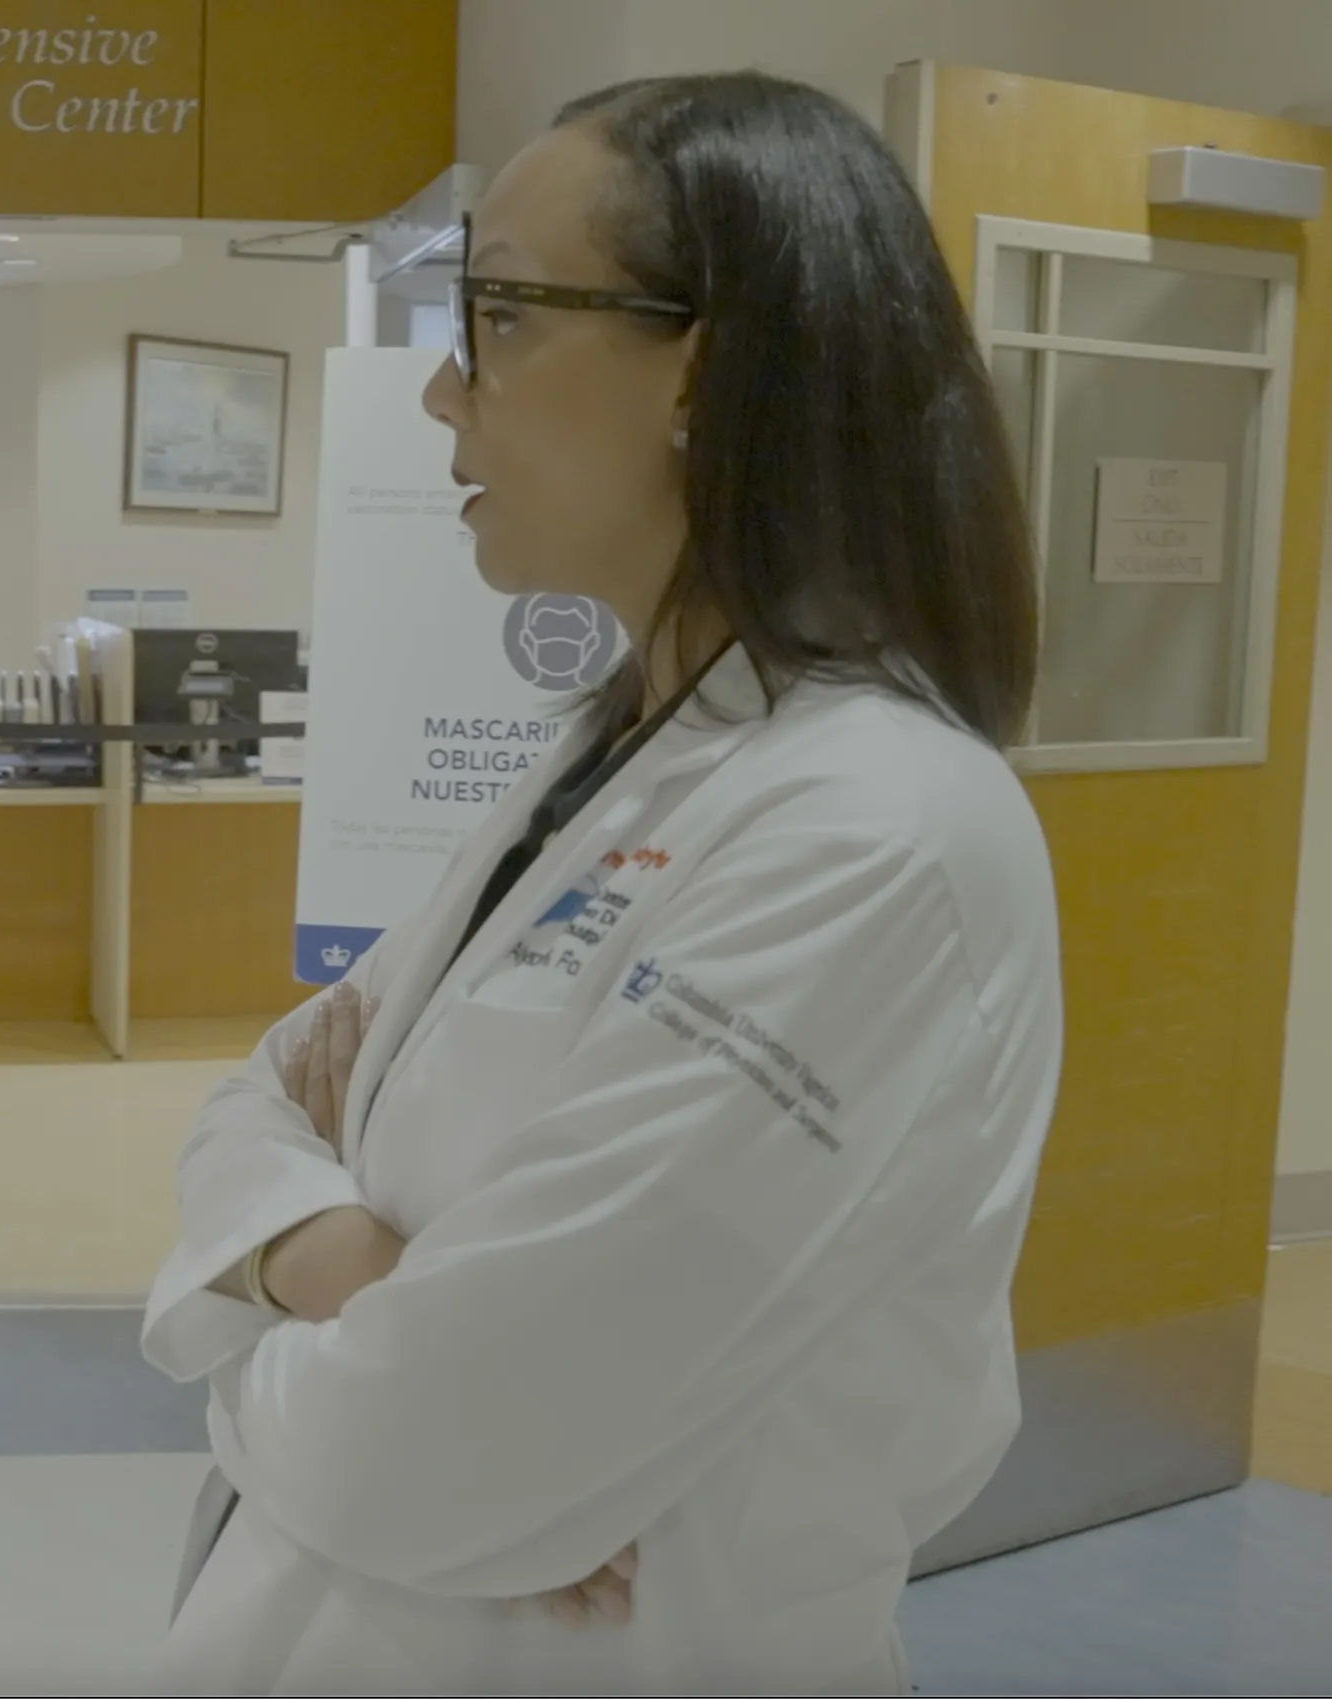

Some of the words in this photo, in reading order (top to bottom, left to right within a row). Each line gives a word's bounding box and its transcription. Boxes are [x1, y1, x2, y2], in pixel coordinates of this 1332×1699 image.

[10, 79, 199, 133] Center
[427, 748, 539, 773] OBLIGA
[556, 949, 582, 977] Fo
